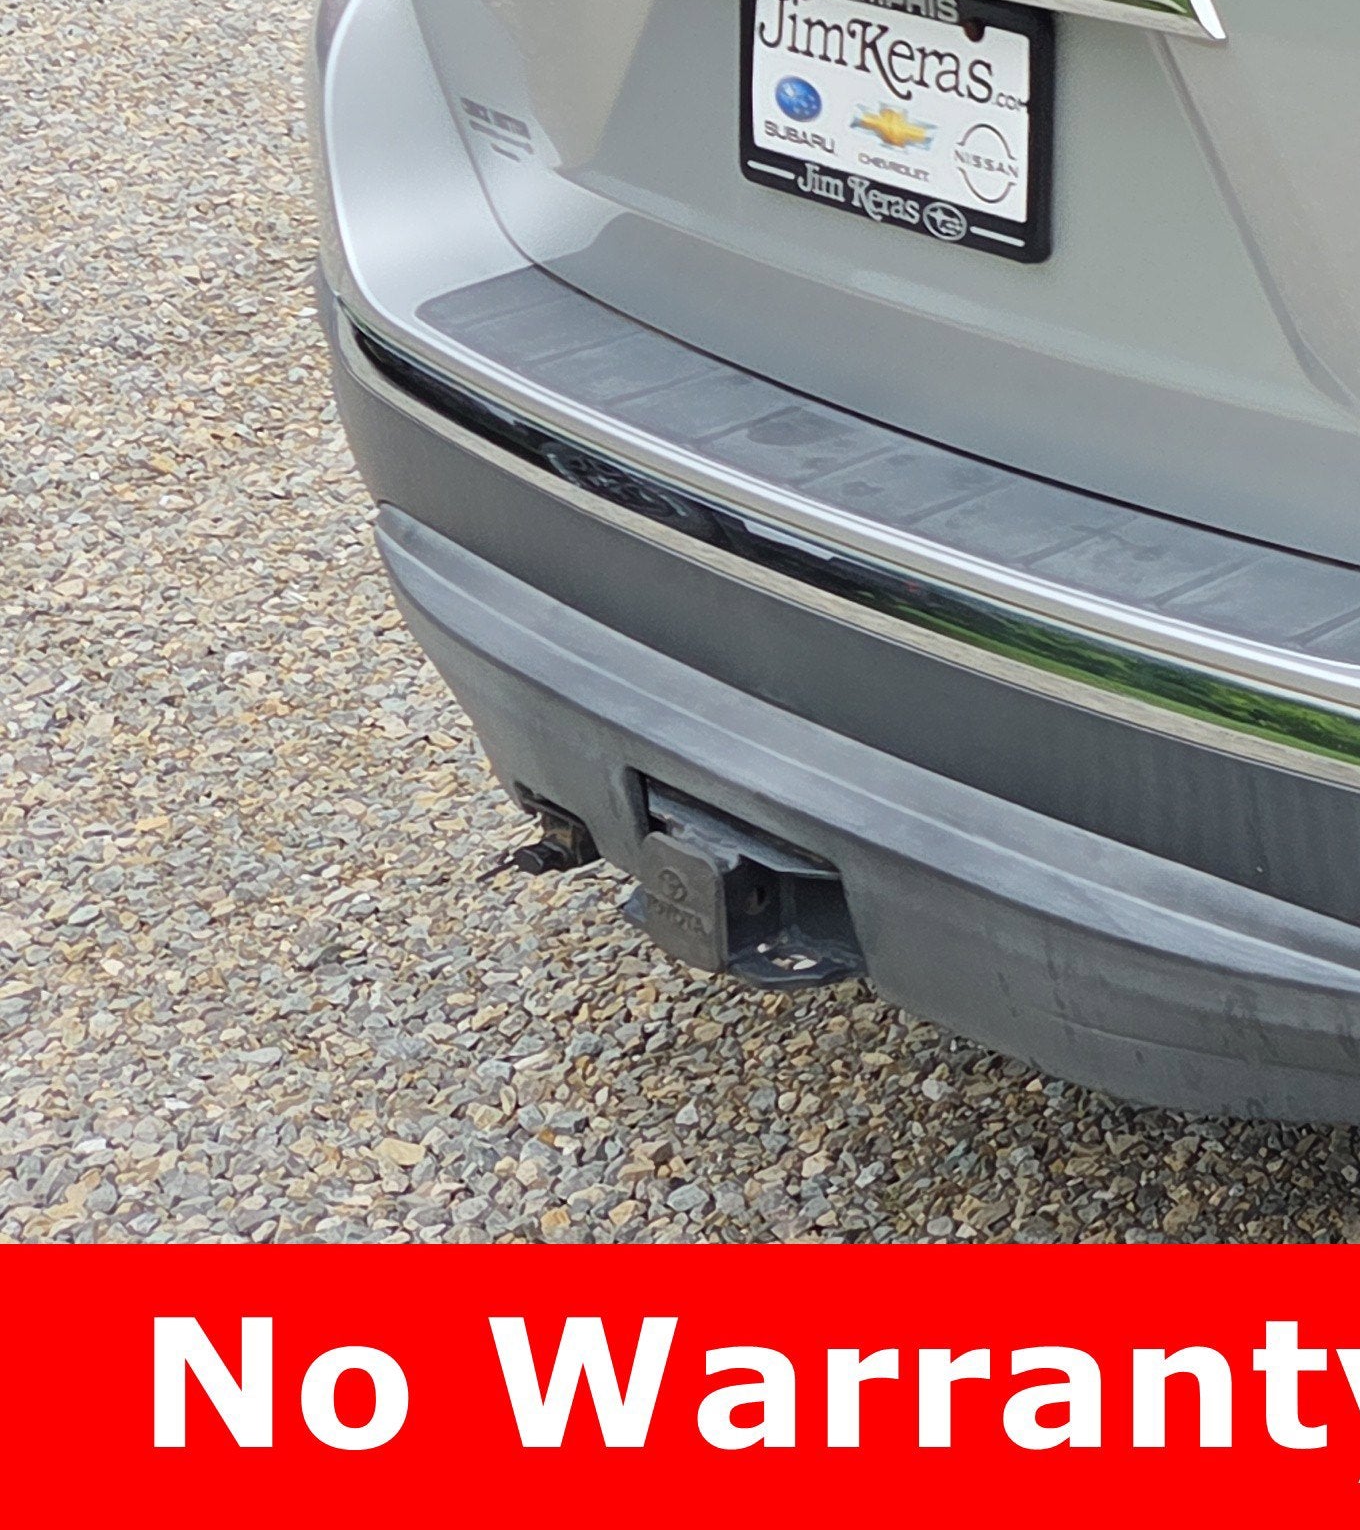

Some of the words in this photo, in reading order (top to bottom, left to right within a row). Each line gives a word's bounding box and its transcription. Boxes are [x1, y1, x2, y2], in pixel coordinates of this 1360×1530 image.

[764, 119, 837, 155] SUBARU
[954, 148, 1019, 179] NISSAN
[797, 162, 844, 204] Jim
[848, 173, 921, 222] Keras
